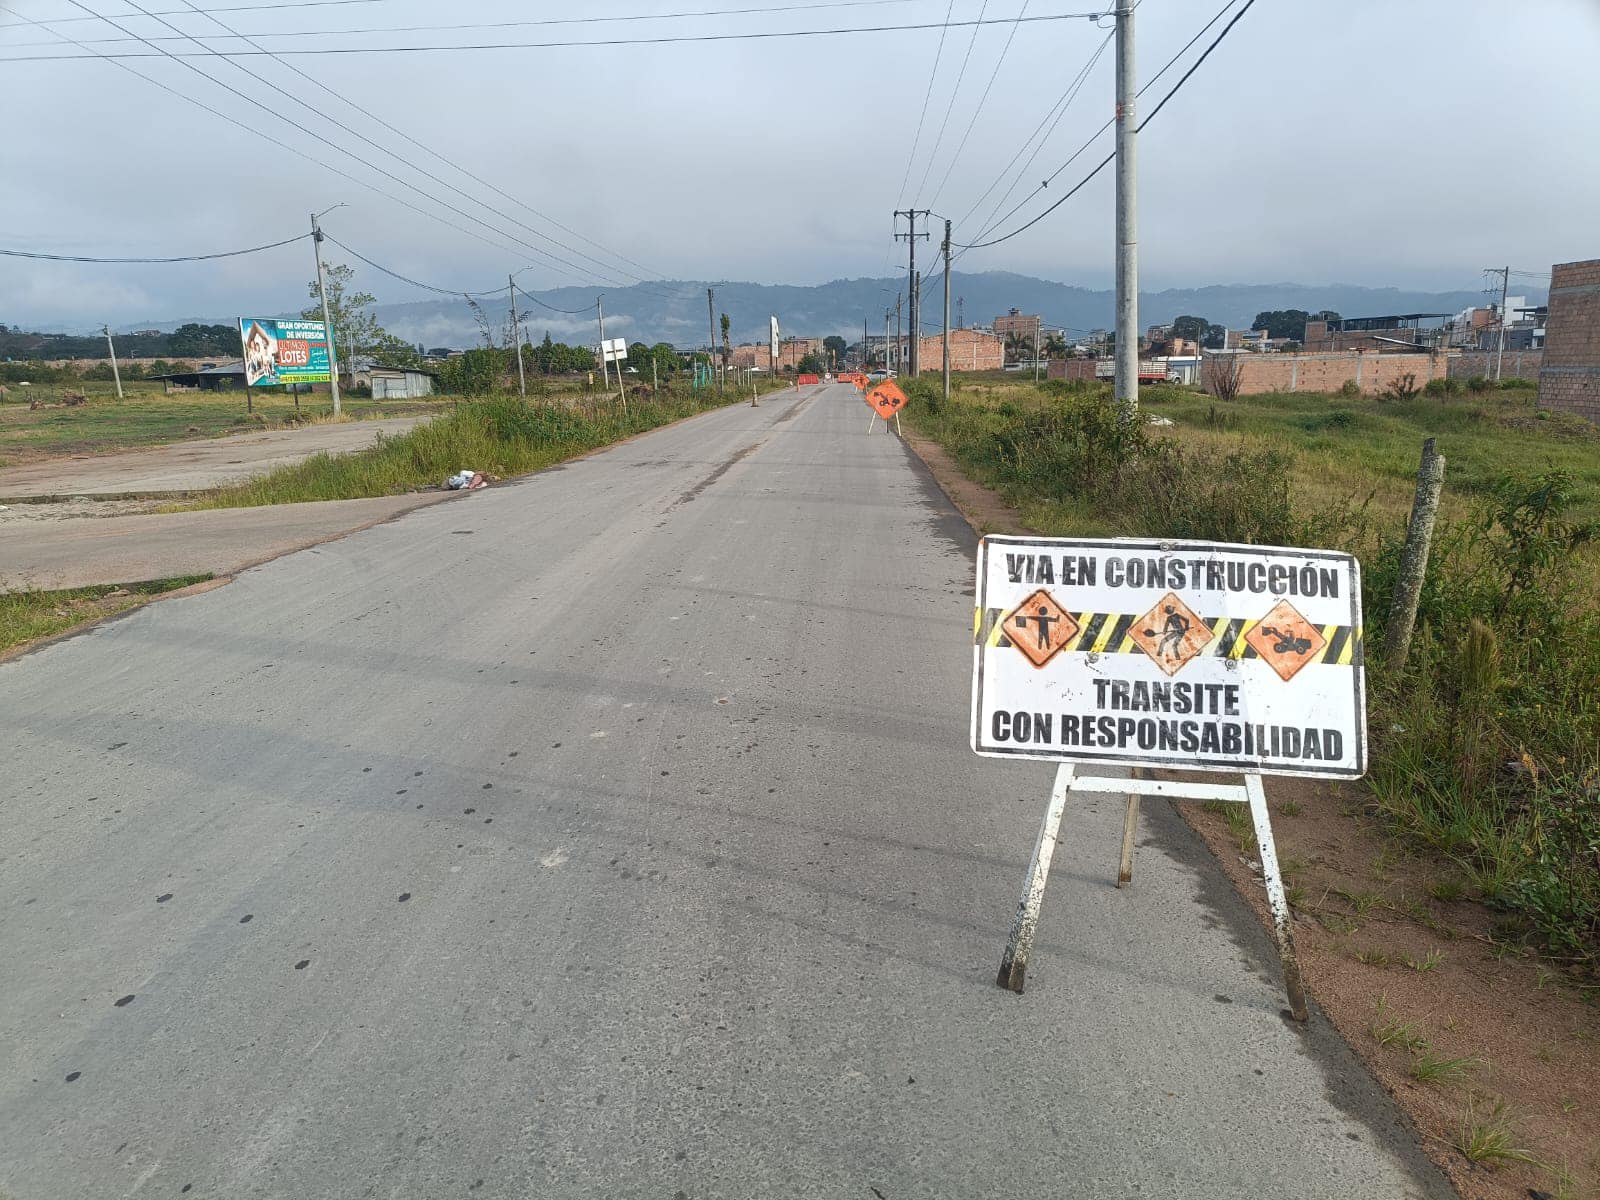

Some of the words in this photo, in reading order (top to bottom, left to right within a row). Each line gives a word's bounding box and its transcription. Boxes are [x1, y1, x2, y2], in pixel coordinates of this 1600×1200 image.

[277, 321, 293, 329] GRAN
[286, 331, 295, 339] DE
[280, 350, 307, 364] LOTES
[1006, 553, 1055, 584] VIA
[1062, 556, 1097, 586] EN
[1105, 557, 1339, 598] CONSTRUCCIÓN
[1093, 678, 1240, 716] TRANSITE
[992, 710, 1052, 744] CON
[1061, 714, 1343, 761] RESPONSABILIDAD
